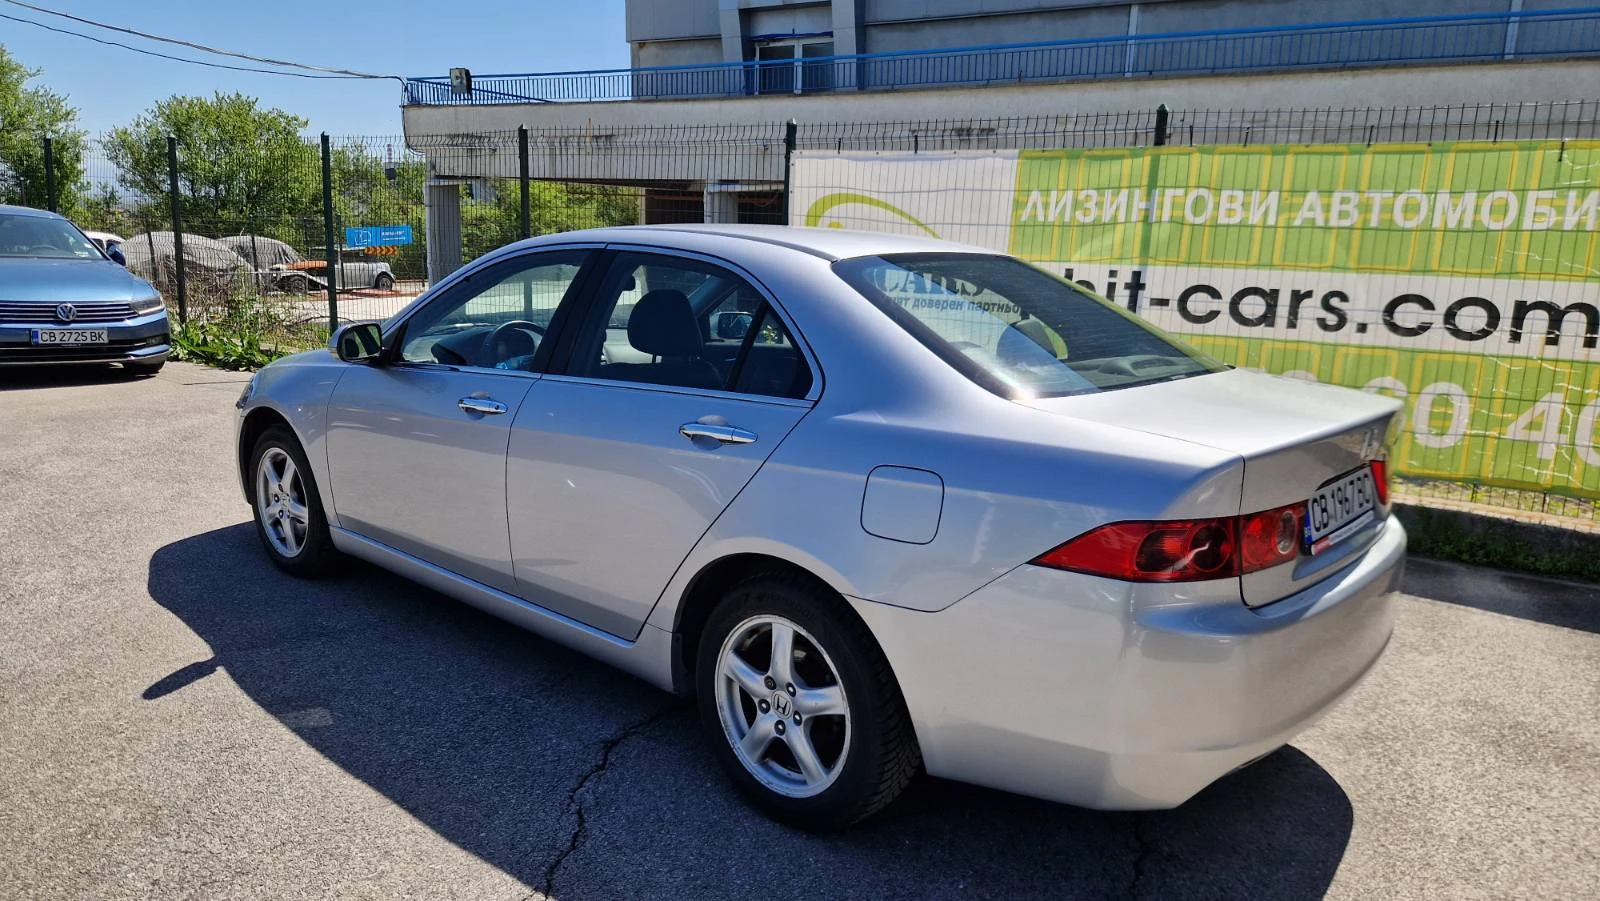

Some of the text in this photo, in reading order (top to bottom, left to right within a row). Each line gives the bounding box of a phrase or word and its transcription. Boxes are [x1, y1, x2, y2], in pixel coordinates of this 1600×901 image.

[1021, 188, 1280, 225] ЛИЗИНГОВИ
[912, 298, 964, 312] доверен
[59, 331, 88, 342] 2725
